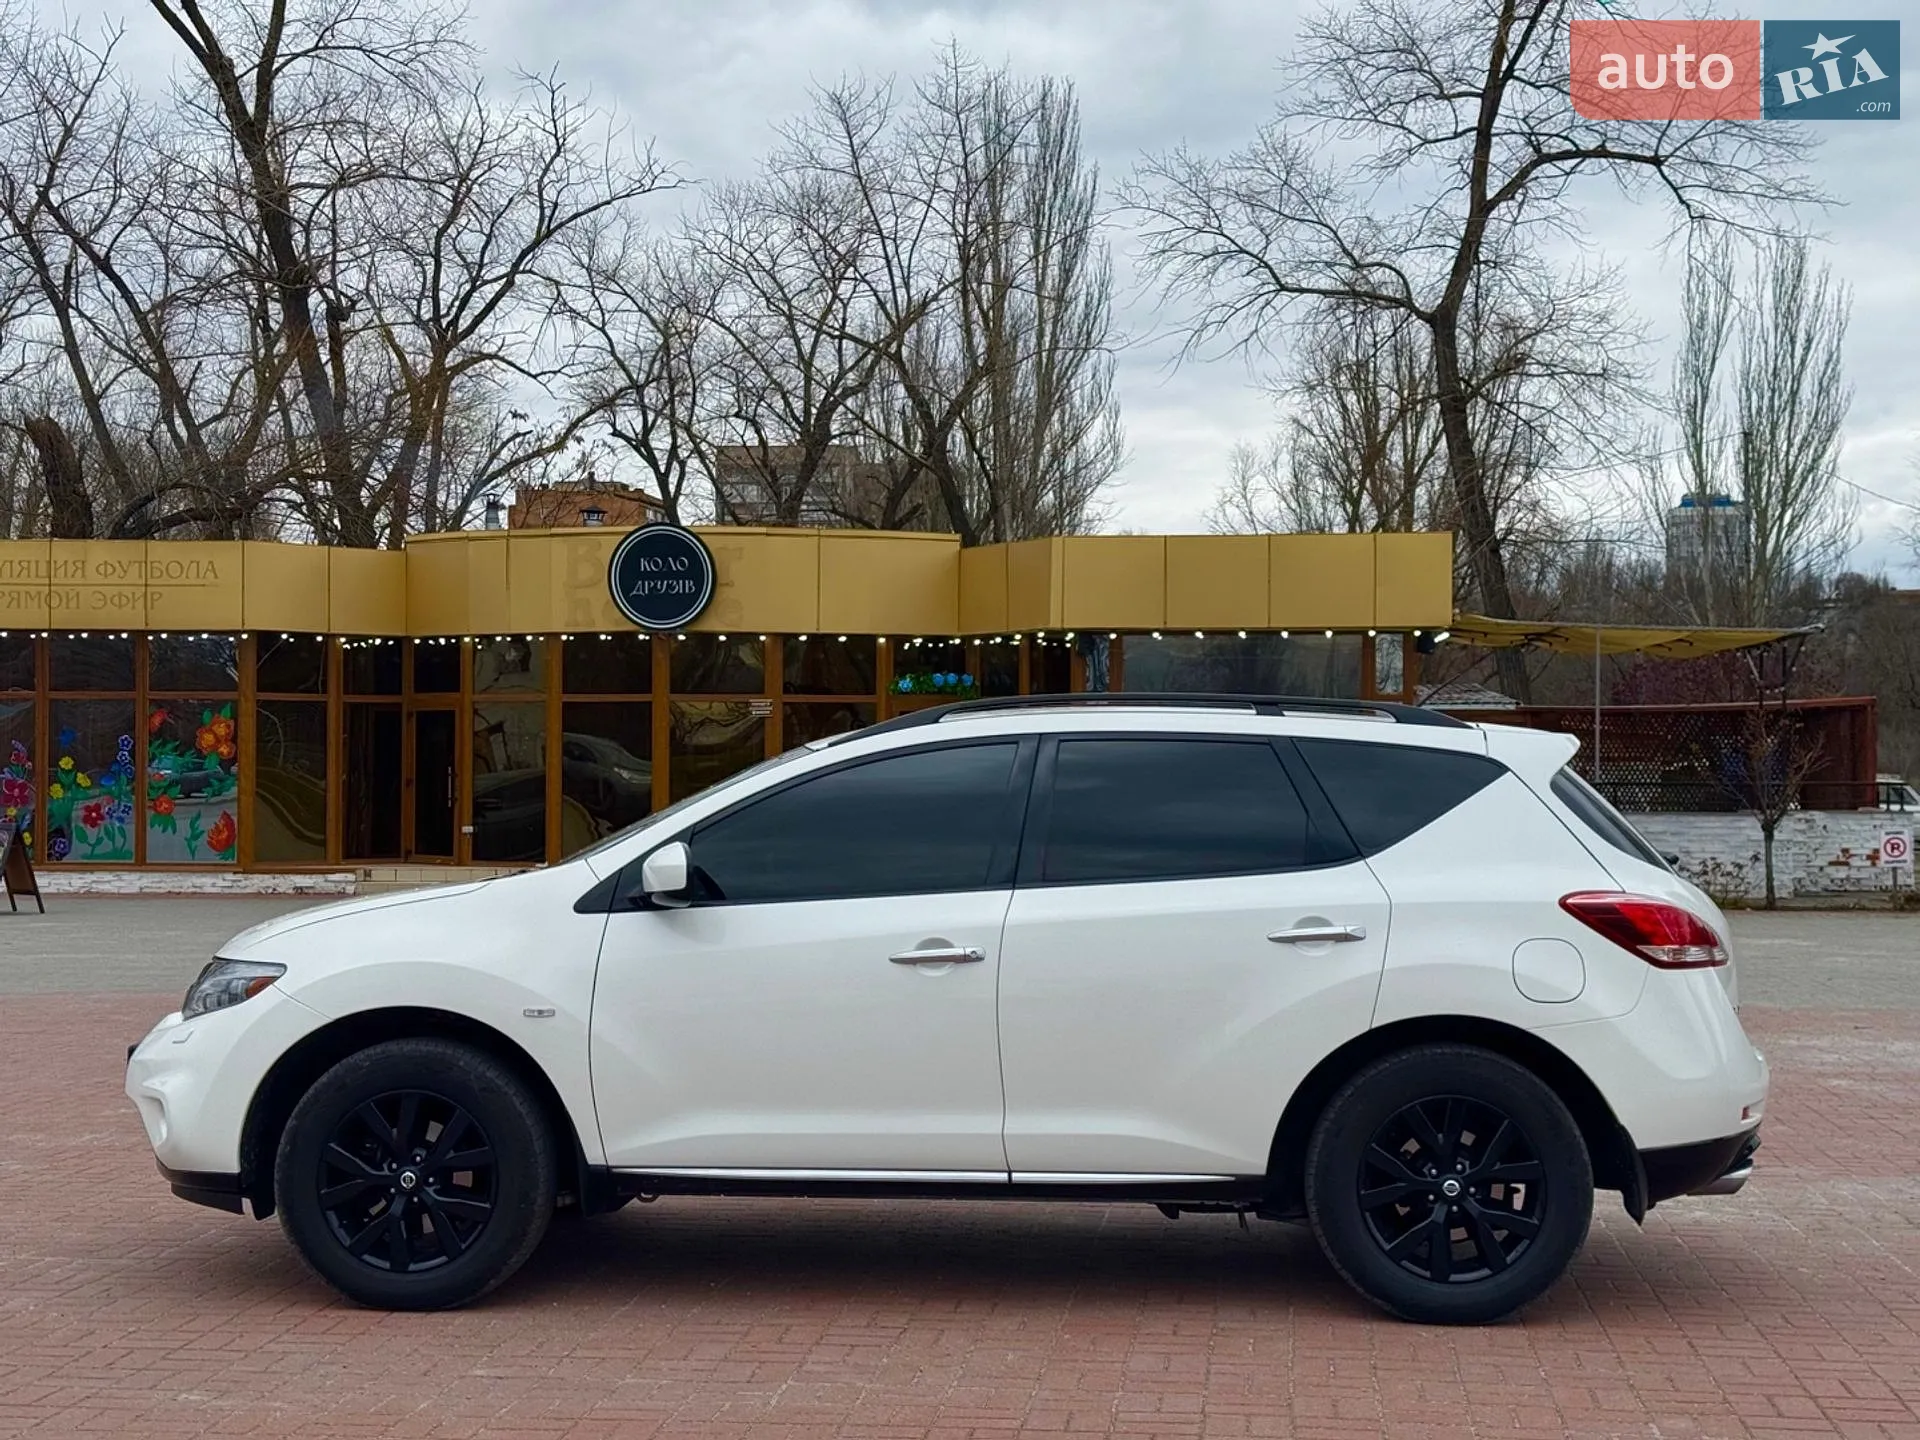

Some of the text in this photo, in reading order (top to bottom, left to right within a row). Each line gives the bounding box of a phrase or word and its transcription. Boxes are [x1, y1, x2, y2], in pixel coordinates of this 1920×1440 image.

[95, 559, 220, 580] ФУТБОЛА
[640, 556, 690, 572] КОЛО
[629, 578, 696, 597] ДРУЗІВ
[89, 590, 164, 611] ЭФИР
